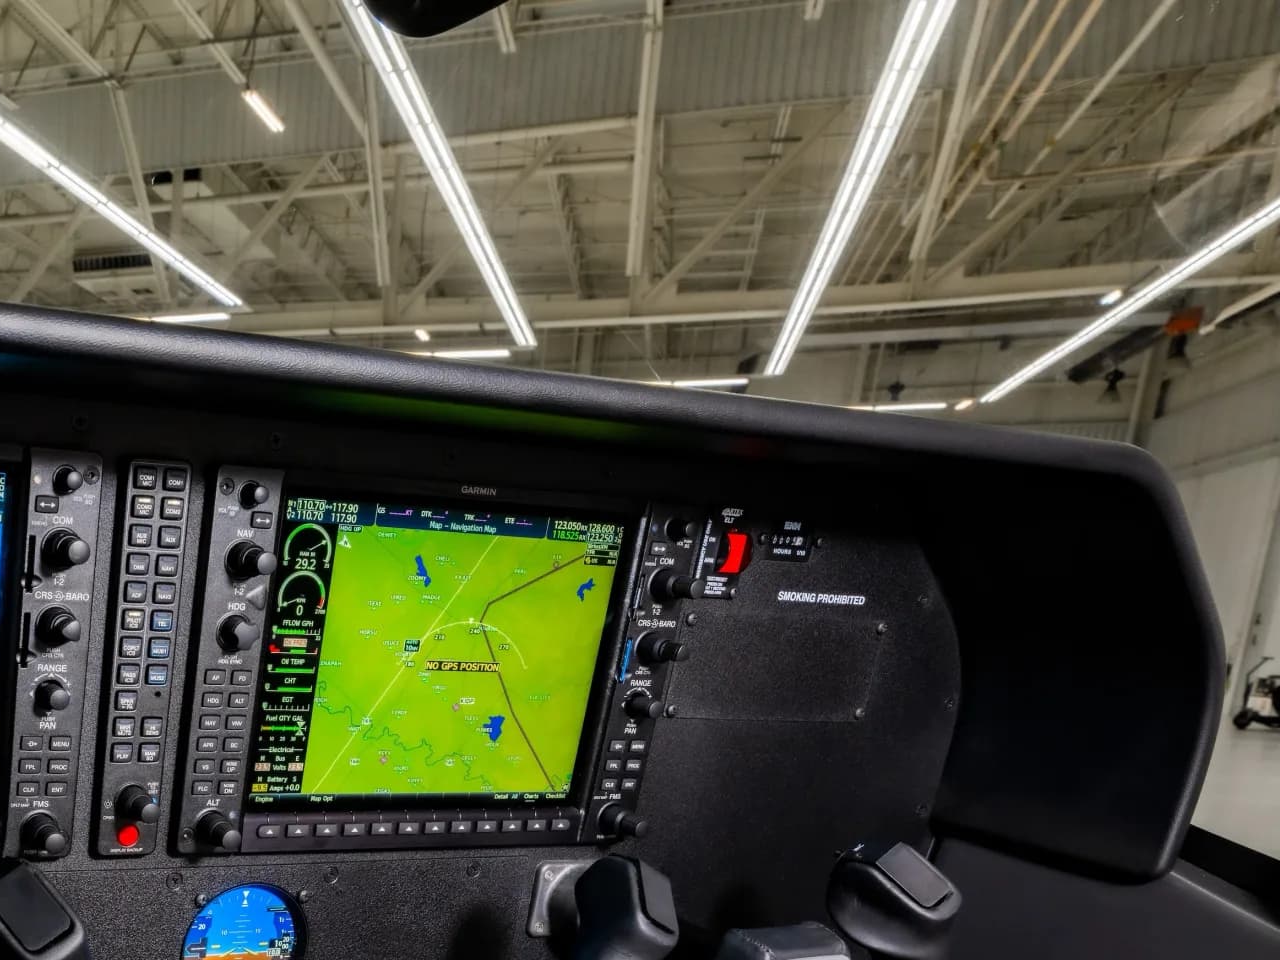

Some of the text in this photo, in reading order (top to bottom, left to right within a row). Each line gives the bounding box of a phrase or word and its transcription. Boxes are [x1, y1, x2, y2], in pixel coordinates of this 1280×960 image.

[461, 485, 496, 495] GARMIN
[298, 500, 358, 513] 110.70 117.90
[53, 516, 73, 525] COM
[430, 521, 496, 534] Map Navigation Map
[295, 559, 316, 569] 29.2
[778, 591, 865, 605] SMOKING PROHIBITED
[37, 664, 67, 672] RANGE
[426, 661, 500, 673] NO GPS POSITION
[39, 721, 56, 730] PAN
[33, 800, 49, 808] FMS
